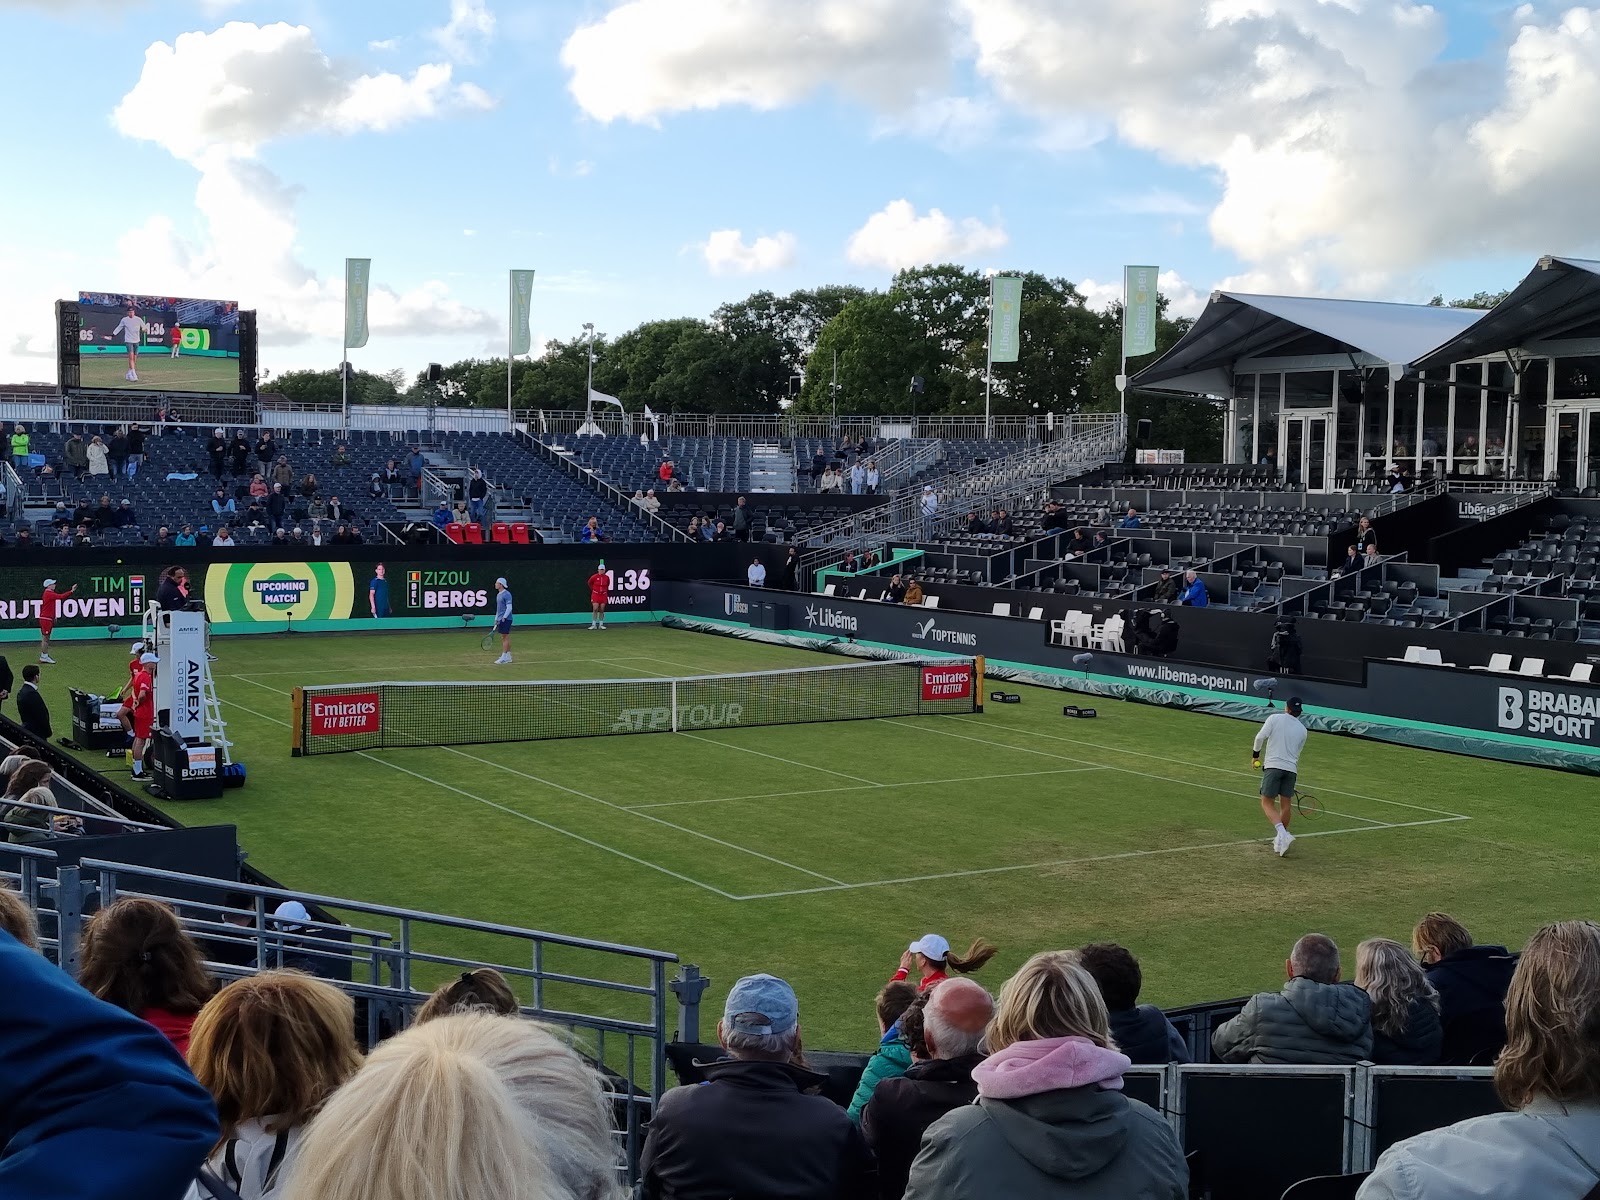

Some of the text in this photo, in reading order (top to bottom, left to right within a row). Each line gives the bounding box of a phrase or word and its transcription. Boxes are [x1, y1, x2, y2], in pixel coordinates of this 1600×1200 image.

[91, 577, 124, 592] TIM
[256, 582, 306, 591] UPCOMING
[424, 571, 470, 586] ZIZOU
[605, 569, 650, 591] 1:36
[133, 588, 141, 613] NED
[265, 594, 297, 603] MATCH
[424, 590, 488, 608] BERGS
[607, 595, 647, 605] WARM UP
[0, 597, 125, 620] RIJTOVEN
[931, 628, 977, 647] TOPTENNIS
[924, 671, 969, 685] Emirates
[1127, 664, 1248, 692] www.libema-open.nl
[187, 659, 200, 724] AMEX
[931, 683, 963, 695] FLY BETTER
[314, 701, 376, 717] Emirates
[1528, 689, 1600, 718] BRABA
[323, 715, 367, 729] FLY BETTER
[677, 703, 743, 727] TOUR
[1528, 711, 1595, 740] SPORT
[181, 767, 216, 777] BOREK
